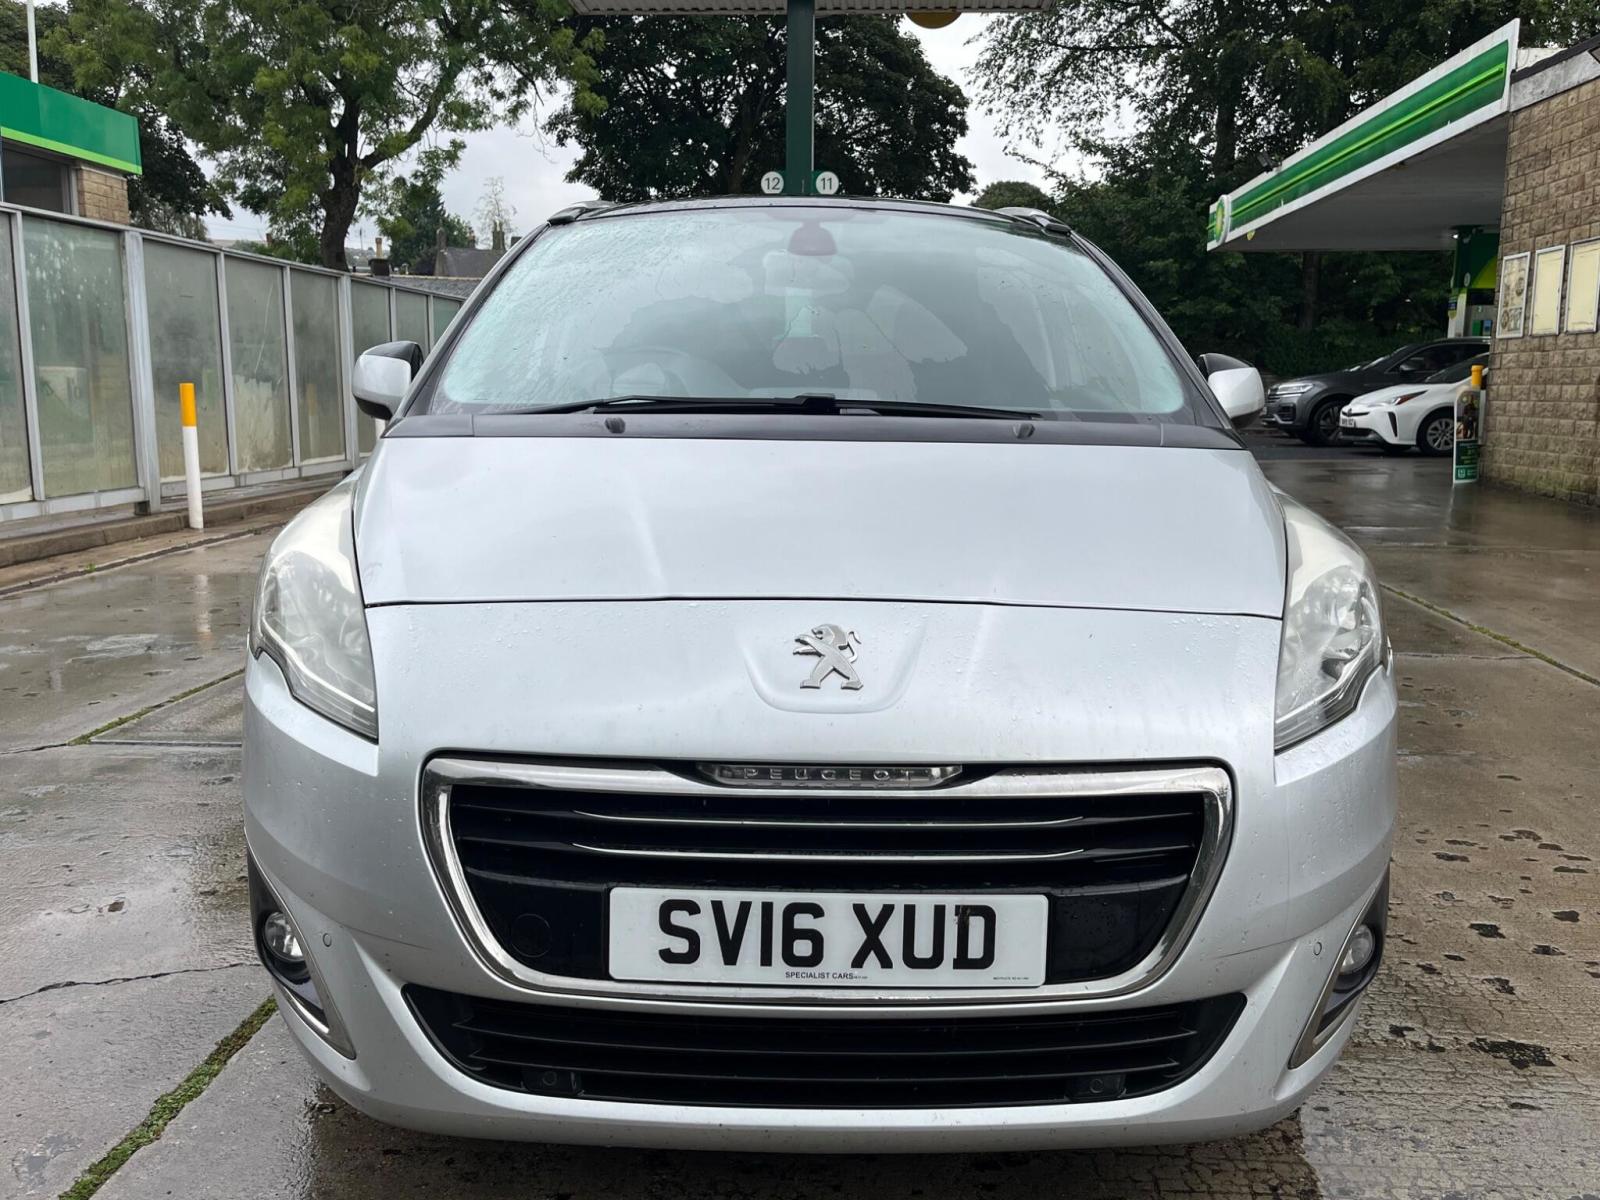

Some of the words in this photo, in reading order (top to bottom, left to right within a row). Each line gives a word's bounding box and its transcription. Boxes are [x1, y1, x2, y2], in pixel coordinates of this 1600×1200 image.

[764, 177, 781, 190] 12
[820, 177, 833, 190] 11
[743, 767, 916, 781] PEUGEOT
[658, 898, 825, 968] SV16
[850, 903, 996, 969] XUD
[785, 971, 830, 979] SPECIALIST
[832, 972, 854, 980] CARS
